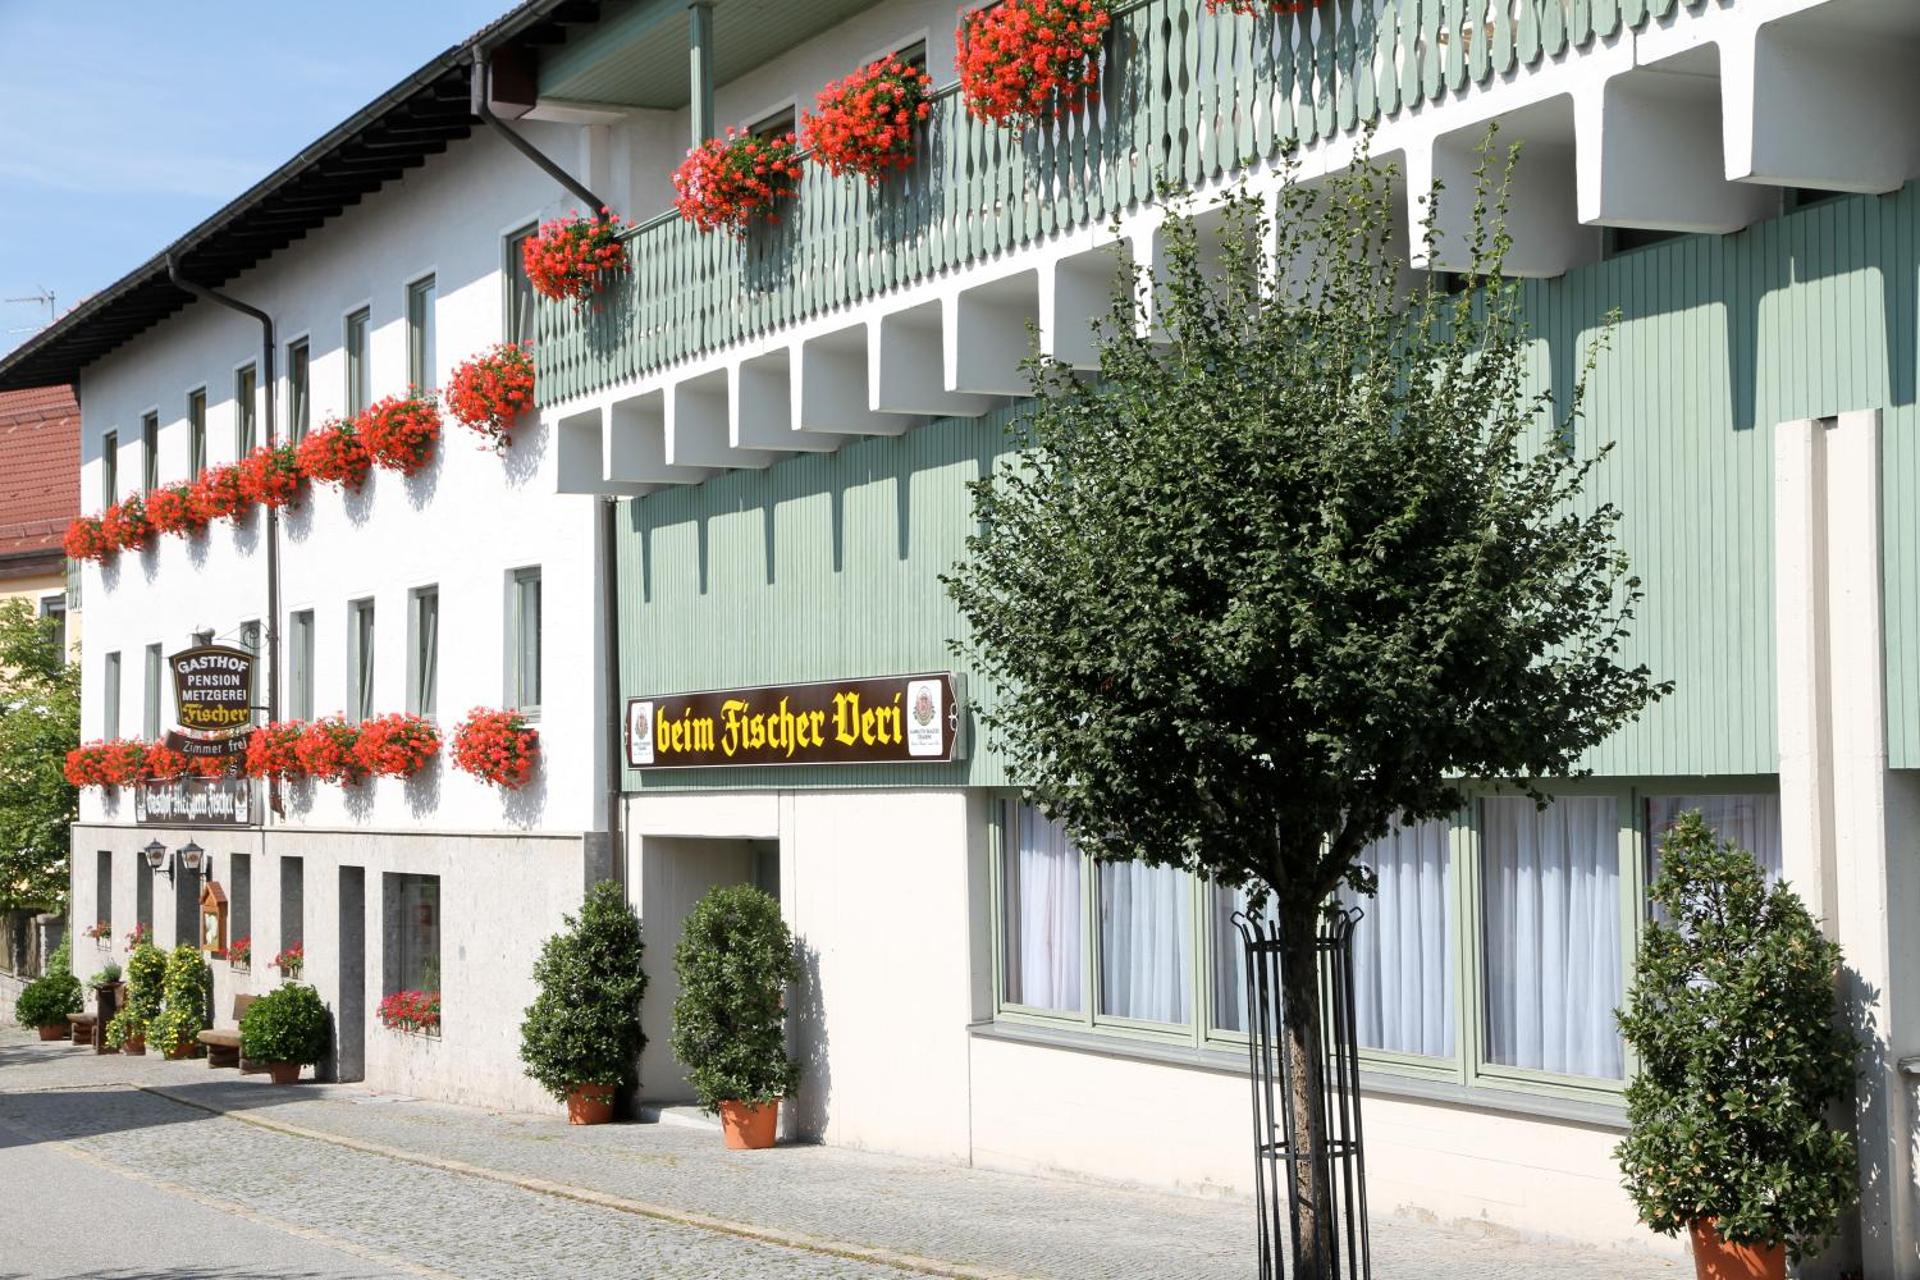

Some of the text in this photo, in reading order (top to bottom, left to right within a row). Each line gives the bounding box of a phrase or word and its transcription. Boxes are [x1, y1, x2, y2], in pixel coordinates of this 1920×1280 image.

[178, 656, 249, 673] GASTHOF
[187, 674, 240, 686] PENSION
[182, 690, 247, 700] METZGEREI
[183, 703, 248, 723] Fischer
[657, 691, 902, 757] beim Fischer Veri
[183, 740, 222, 754] Zimmer
